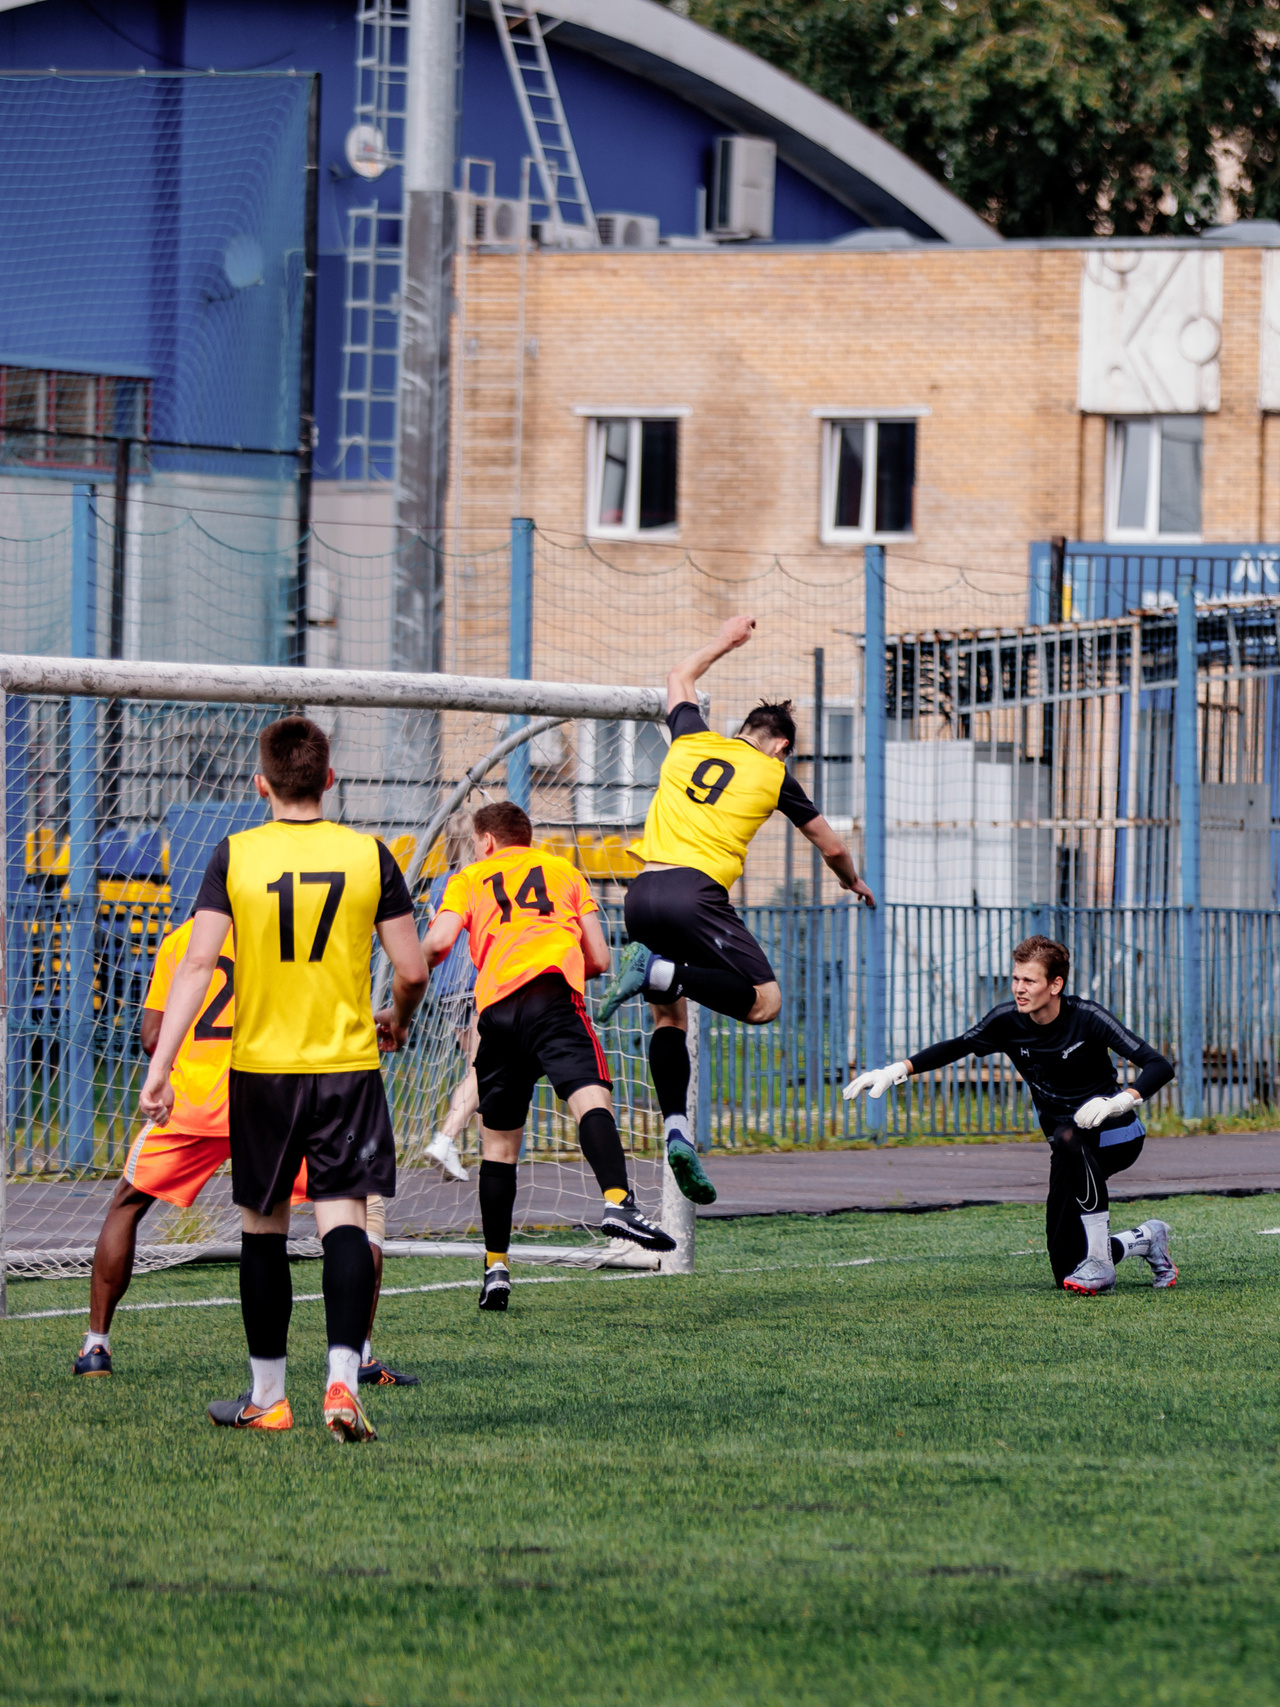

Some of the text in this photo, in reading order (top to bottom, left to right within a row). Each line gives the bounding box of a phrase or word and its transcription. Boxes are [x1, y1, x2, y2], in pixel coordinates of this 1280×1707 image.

[686, 758, 735, 806] 9
[267, 871, 345, 962] 17
[483, 865, 555, 925] 14
